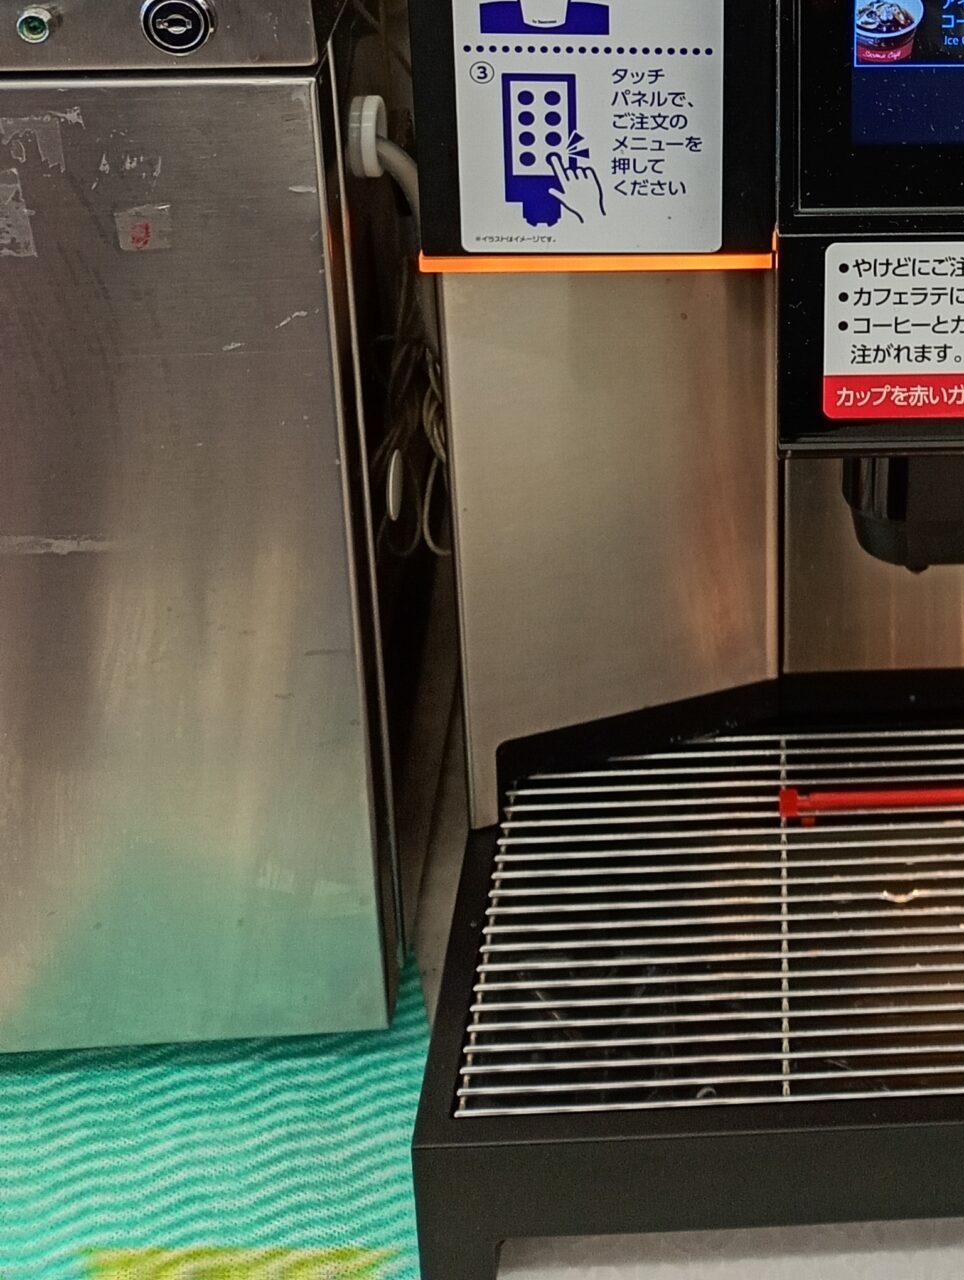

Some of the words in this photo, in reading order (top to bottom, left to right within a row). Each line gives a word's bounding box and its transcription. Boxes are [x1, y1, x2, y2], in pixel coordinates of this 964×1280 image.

[944, 35, 959, 46] Ice
[611, 68, 665, 84] タッチ
[611, 91, 695, 107] パネルで、
[612, 113, 688, 130] ご注文の
[612, 136, 702, 152] メニューを
[611, 158, 664, 175] 押して
[613, 179, 687, 196] ください
[851, 344, 964, 365] 注がれます。
